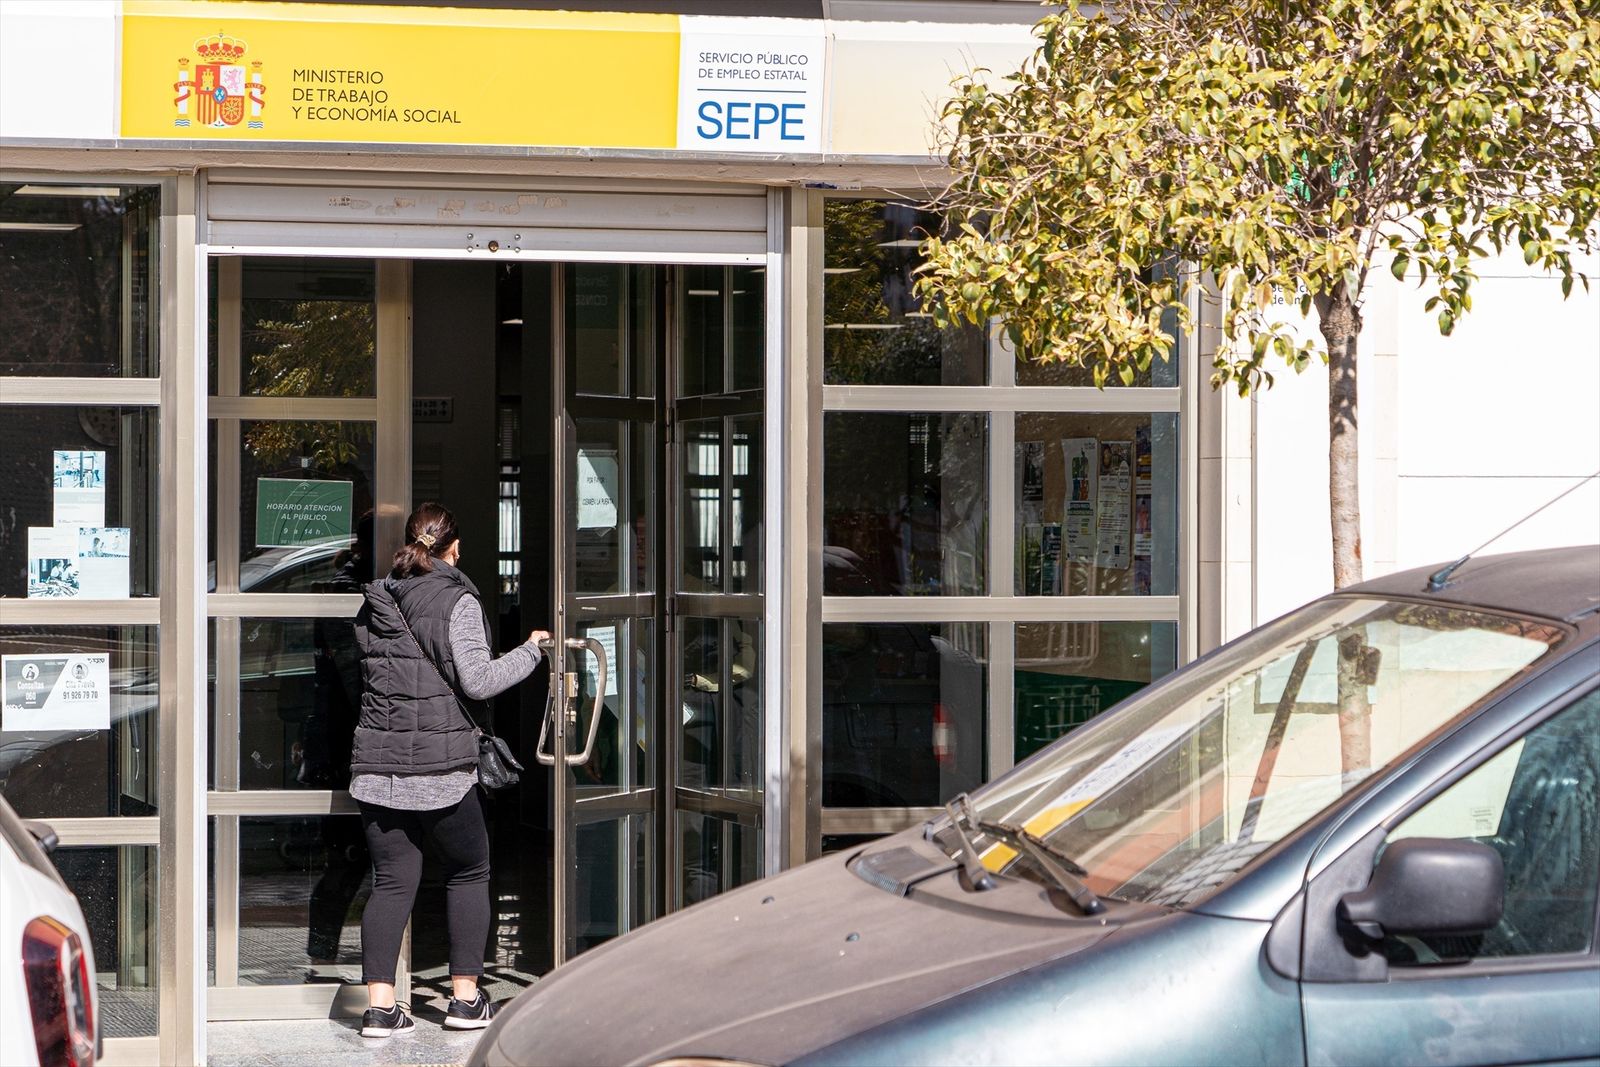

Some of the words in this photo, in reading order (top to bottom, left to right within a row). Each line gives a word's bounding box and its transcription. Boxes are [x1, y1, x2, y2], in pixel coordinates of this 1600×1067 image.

[699, 52, 753, 65] SERVICIO
[757, 51, 808, 66] PÚBLICO
[293, 69, 384, 84] MINISTERIO
[698, 68, 714, 79] DE
[717, 69, 761, 80] EMPLEO
[764, 70, 808, 81] ESTATAL
[292, 88, 314, 102] DE
[316, 88, 388, 107] TRABAJO
[292, 106, 302, 120] Y
[307, 105, 399, 122] ECONOMÍA
[403, 109, 462, 124] SOCIAL
[697, 101, 806, 140] SEPE
[266, 503, 302, 511] HORARIO
[303, 504, 343, 512] ATENCION
[283, 527, 289, 535] 9
